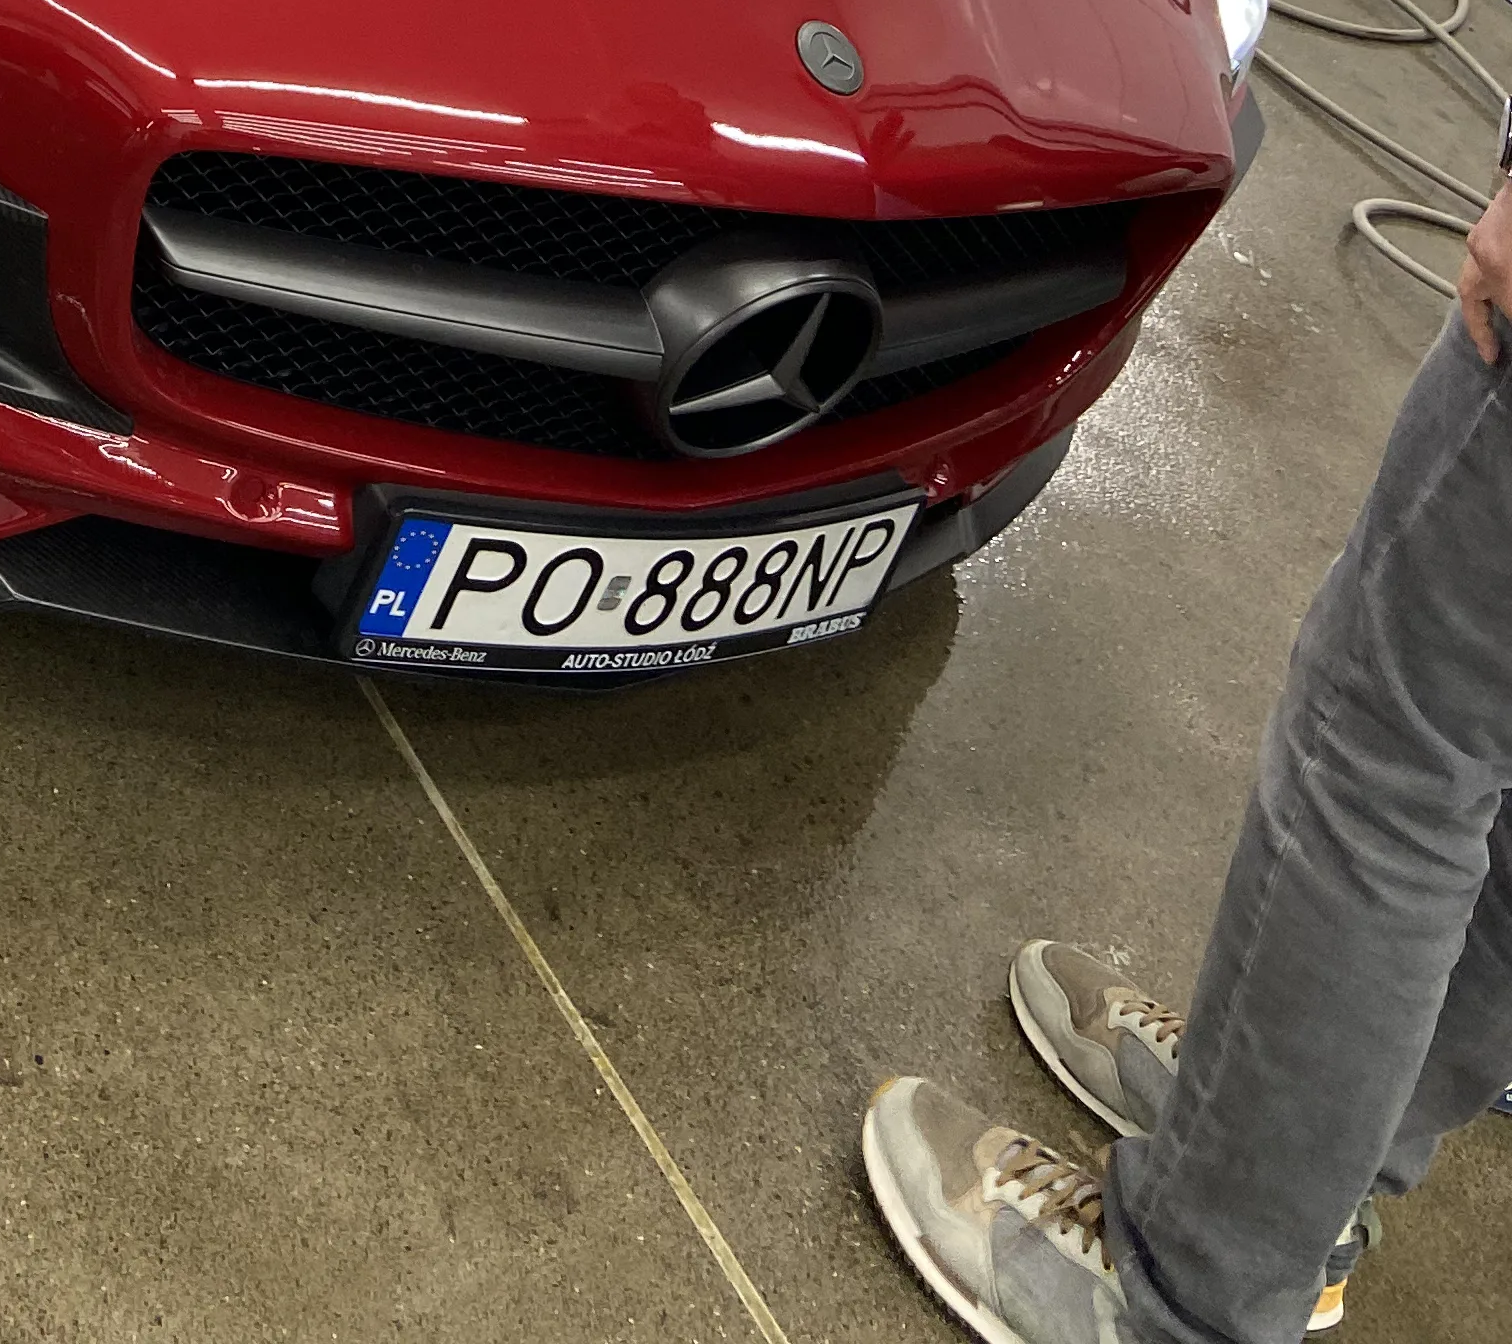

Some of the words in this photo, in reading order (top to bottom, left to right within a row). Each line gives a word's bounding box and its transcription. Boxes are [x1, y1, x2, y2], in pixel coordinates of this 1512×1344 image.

[430, 537, 605, 637] PO
[623, 518, 896, 637] 888NP
[369, 589, 407, 617] PL
[787, 611, 867, 644] BRABUS
[377, 641, 487, 663] Mercedes-Benz
[561, 650, 672, 669] AUTO-STUDIO
[674, 641, 718, 664] ŁÓDŹ
